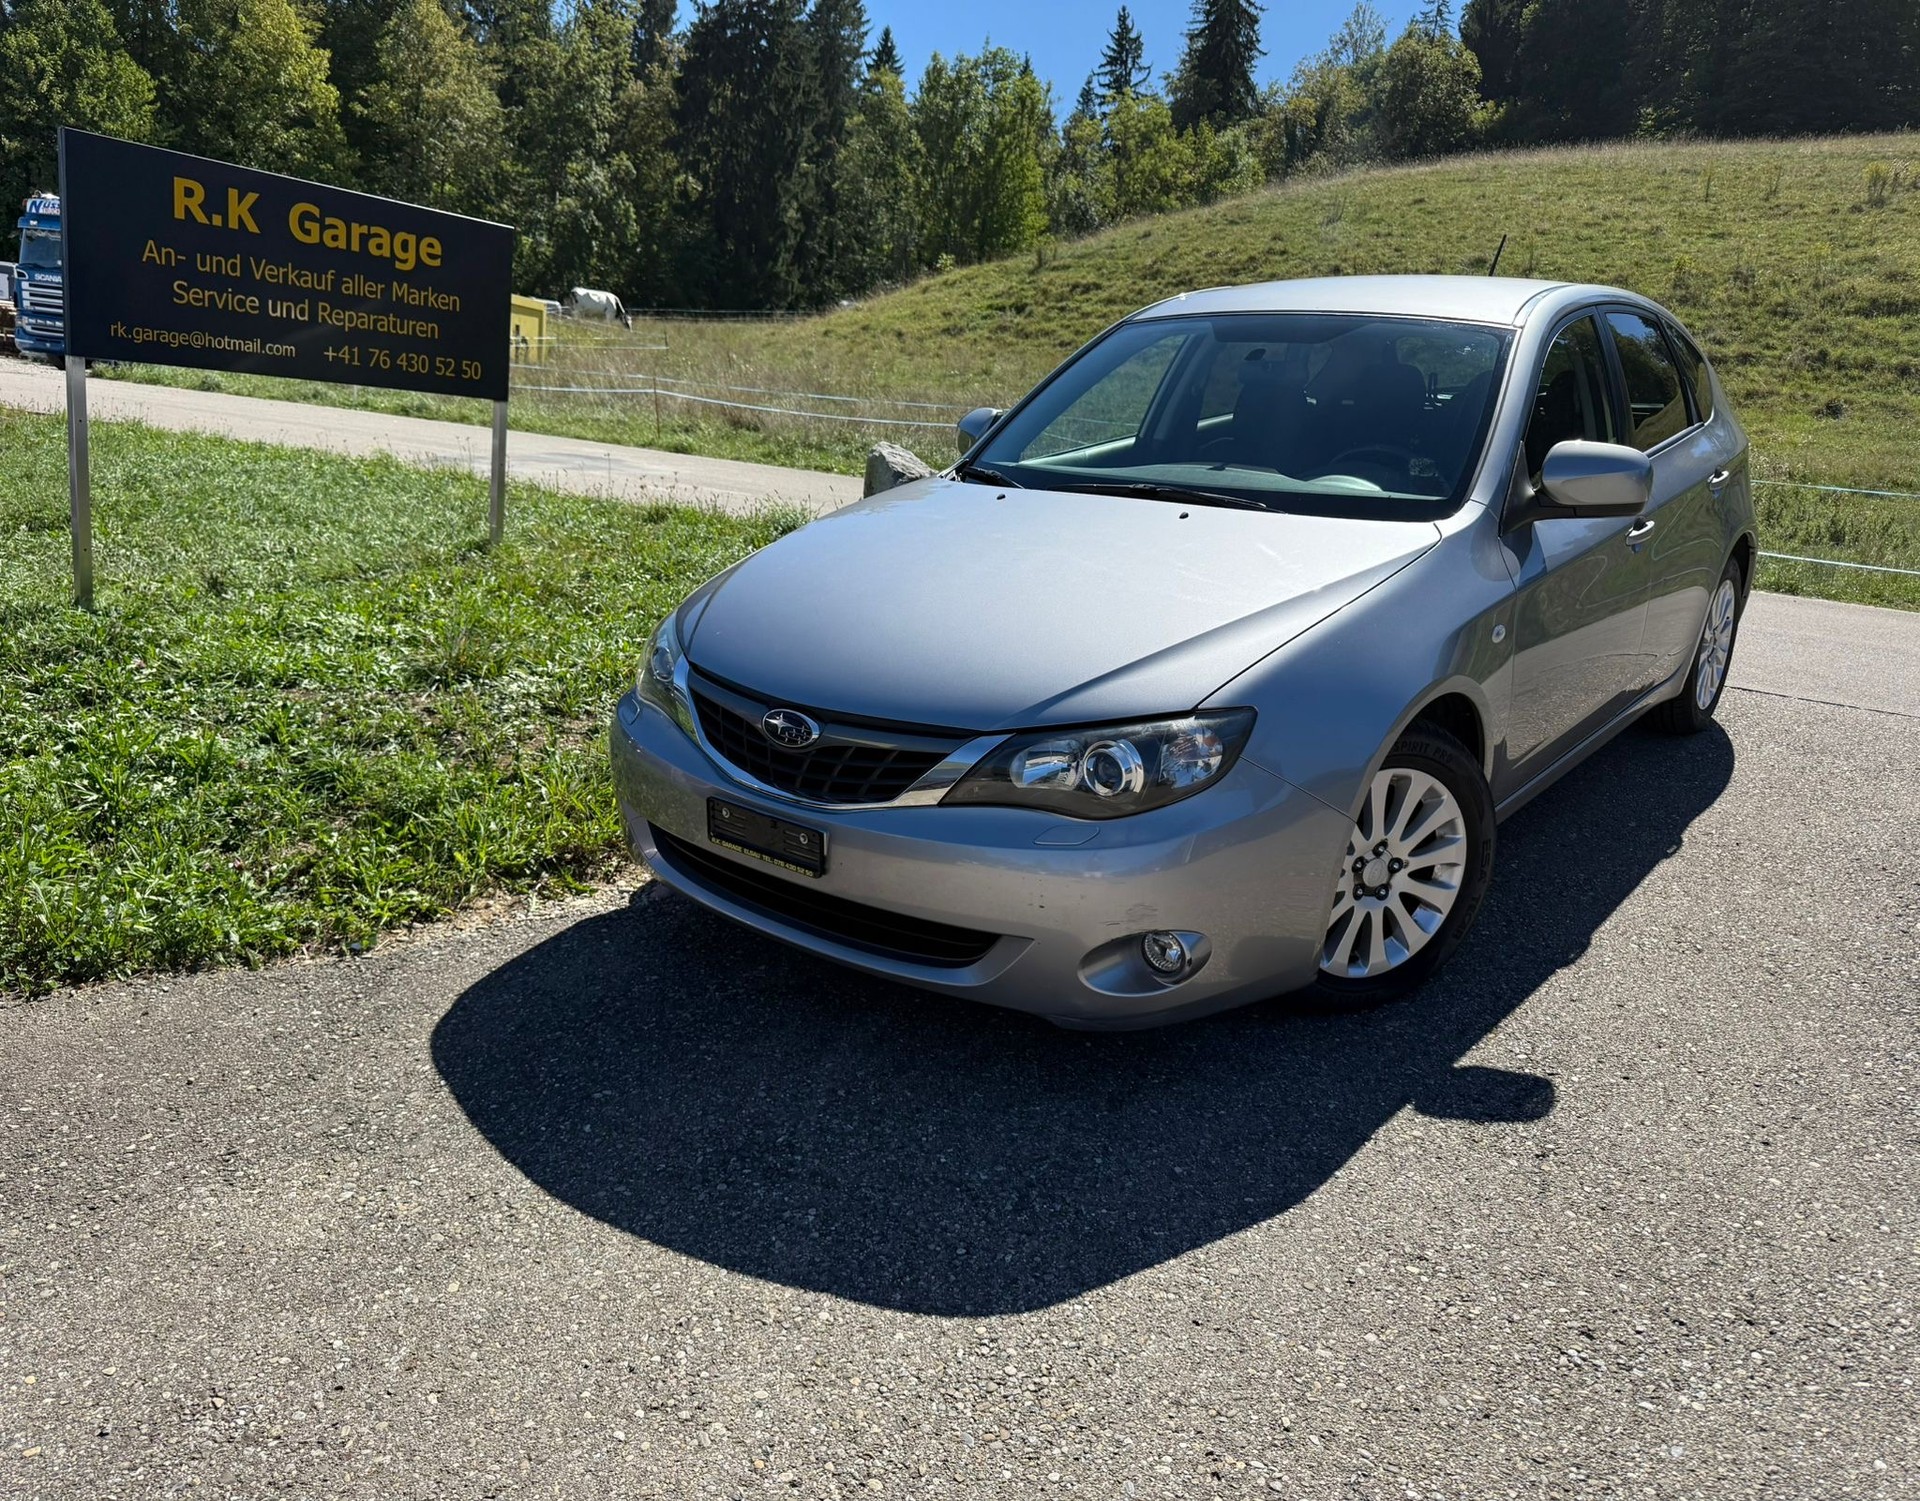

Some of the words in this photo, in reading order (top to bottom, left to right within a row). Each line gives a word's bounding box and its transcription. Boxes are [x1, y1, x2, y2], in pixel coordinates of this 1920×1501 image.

[173, 176, 261, 234] R.K
[288, 202, 442, 271] Garage
[34, 273, 62, 283] SCANIA
[142, 239, 187, 267] An-
[196, 252, 240, 277] und
[250, 256, 335, 292] Verkauf
[341, 273, 385, 299] aller
[392, 281, 460, 312] Marken
[173, 280, 260, 314] Service
[268, 299, 309, 321] und
[318, 302, 439, 339] Reparaturen
[110, 321, 296, 358] rk.garage@hotmail.com
[323, 345, 361, 366] +41
[368, 348, 391, 370] 76
[396, 352, 429, 374] 430
[435, 357, 456, 377] 52
[461, 360, 482, 380] 50
[721, 841, 742, 853] GARAGE
